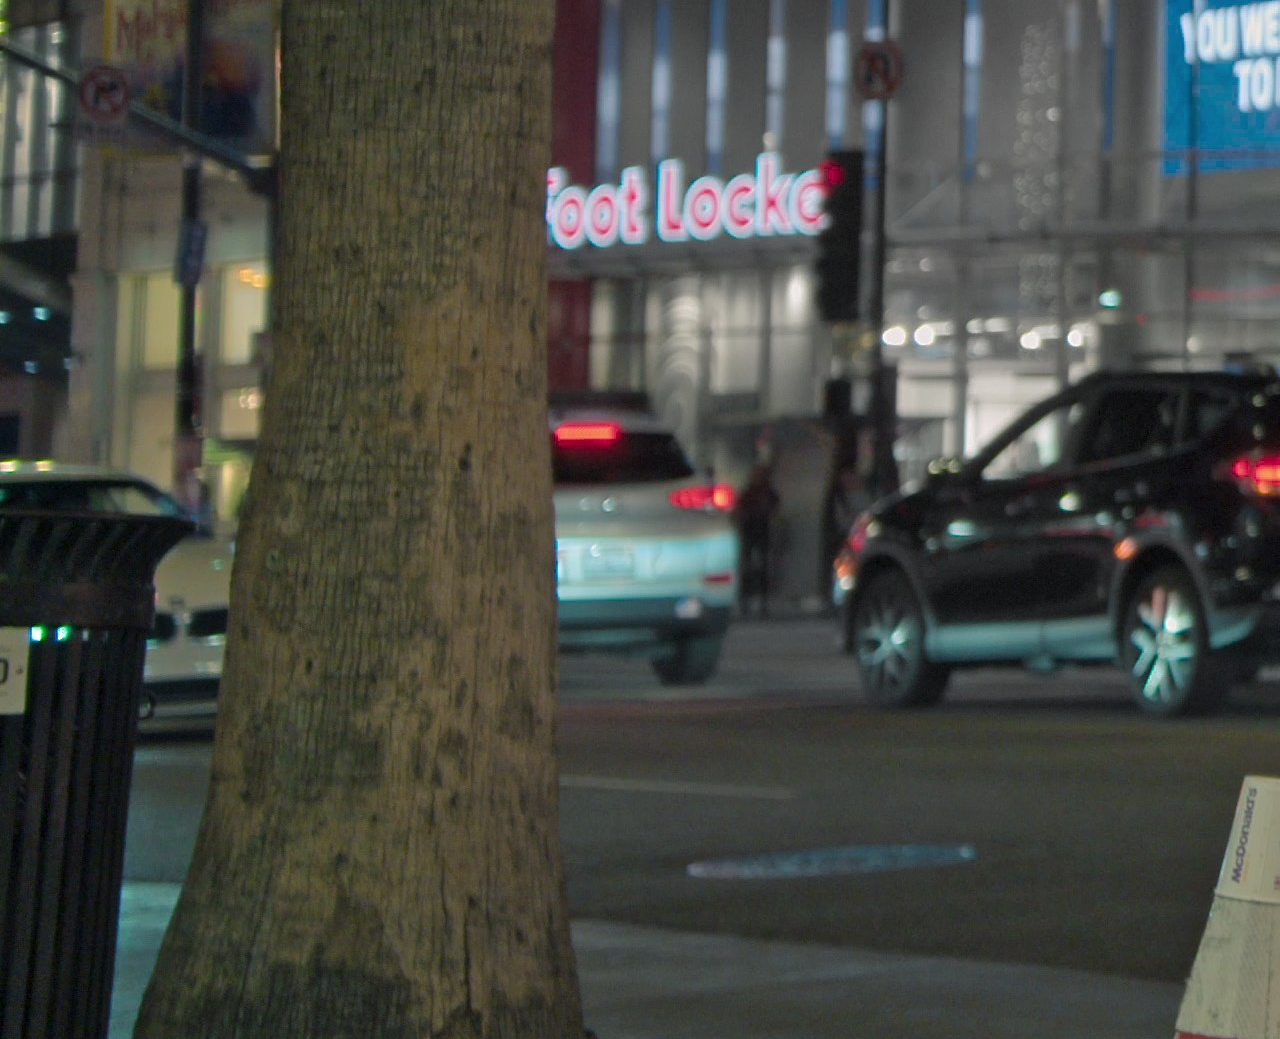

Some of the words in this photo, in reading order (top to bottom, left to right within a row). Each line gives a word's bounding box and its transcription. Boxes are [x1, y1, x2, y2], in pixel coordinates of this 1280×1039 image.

[1180, 7, 1240, 64] YOU
[1233, 57, 1273, 113] TO
[656, 151, 832, 243] Locke
